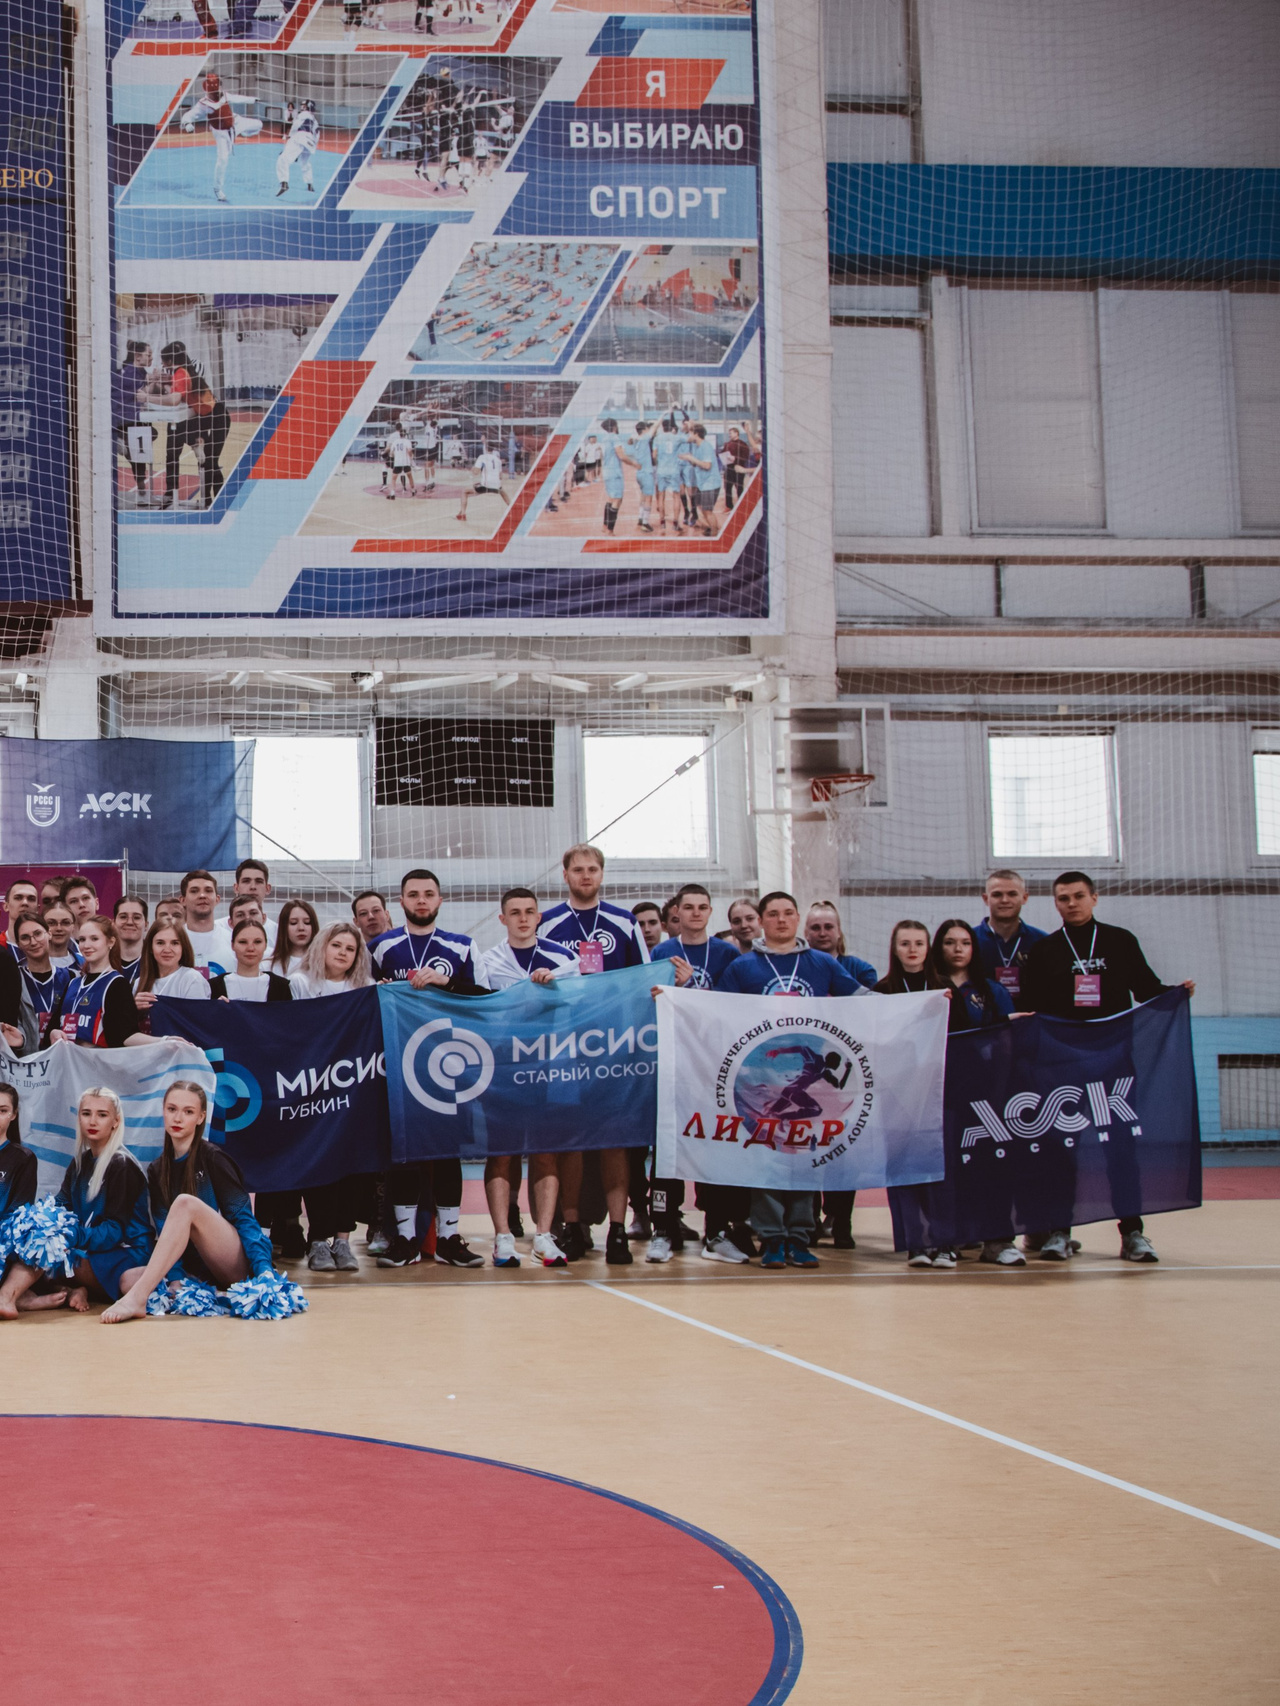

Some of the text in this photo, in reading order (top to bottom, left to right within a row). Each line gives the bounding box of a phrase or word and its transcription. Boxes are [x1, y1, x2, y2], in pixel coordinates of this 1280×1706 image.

[645, 70, 666, 98] Я
[570, 122, 744, 150] ВЫБИРАЮ
[589, 185, 727, 219] СПОРТ
[136, 435, 145, 454] 1
[79, 791, 153, 813] АССК
[512, 1024, 658, 1063] МИСИС
[513, 1062, 591, 1085] СТАРЫЙ
[279, 1094, 351, 1121] ГУБКИН
[716, 1017, 874, 1168] СТУДЕНЧЕСКИЙ СПОРТИВНЫЙ КЛУБ ОГАПОУ ШАРТ
[961, 1076, 1139, 1148] АССК
[682, 1112, 845, 1150] ЛИДЕР
[961, 1126, 1142, 1164] РОССИИ
